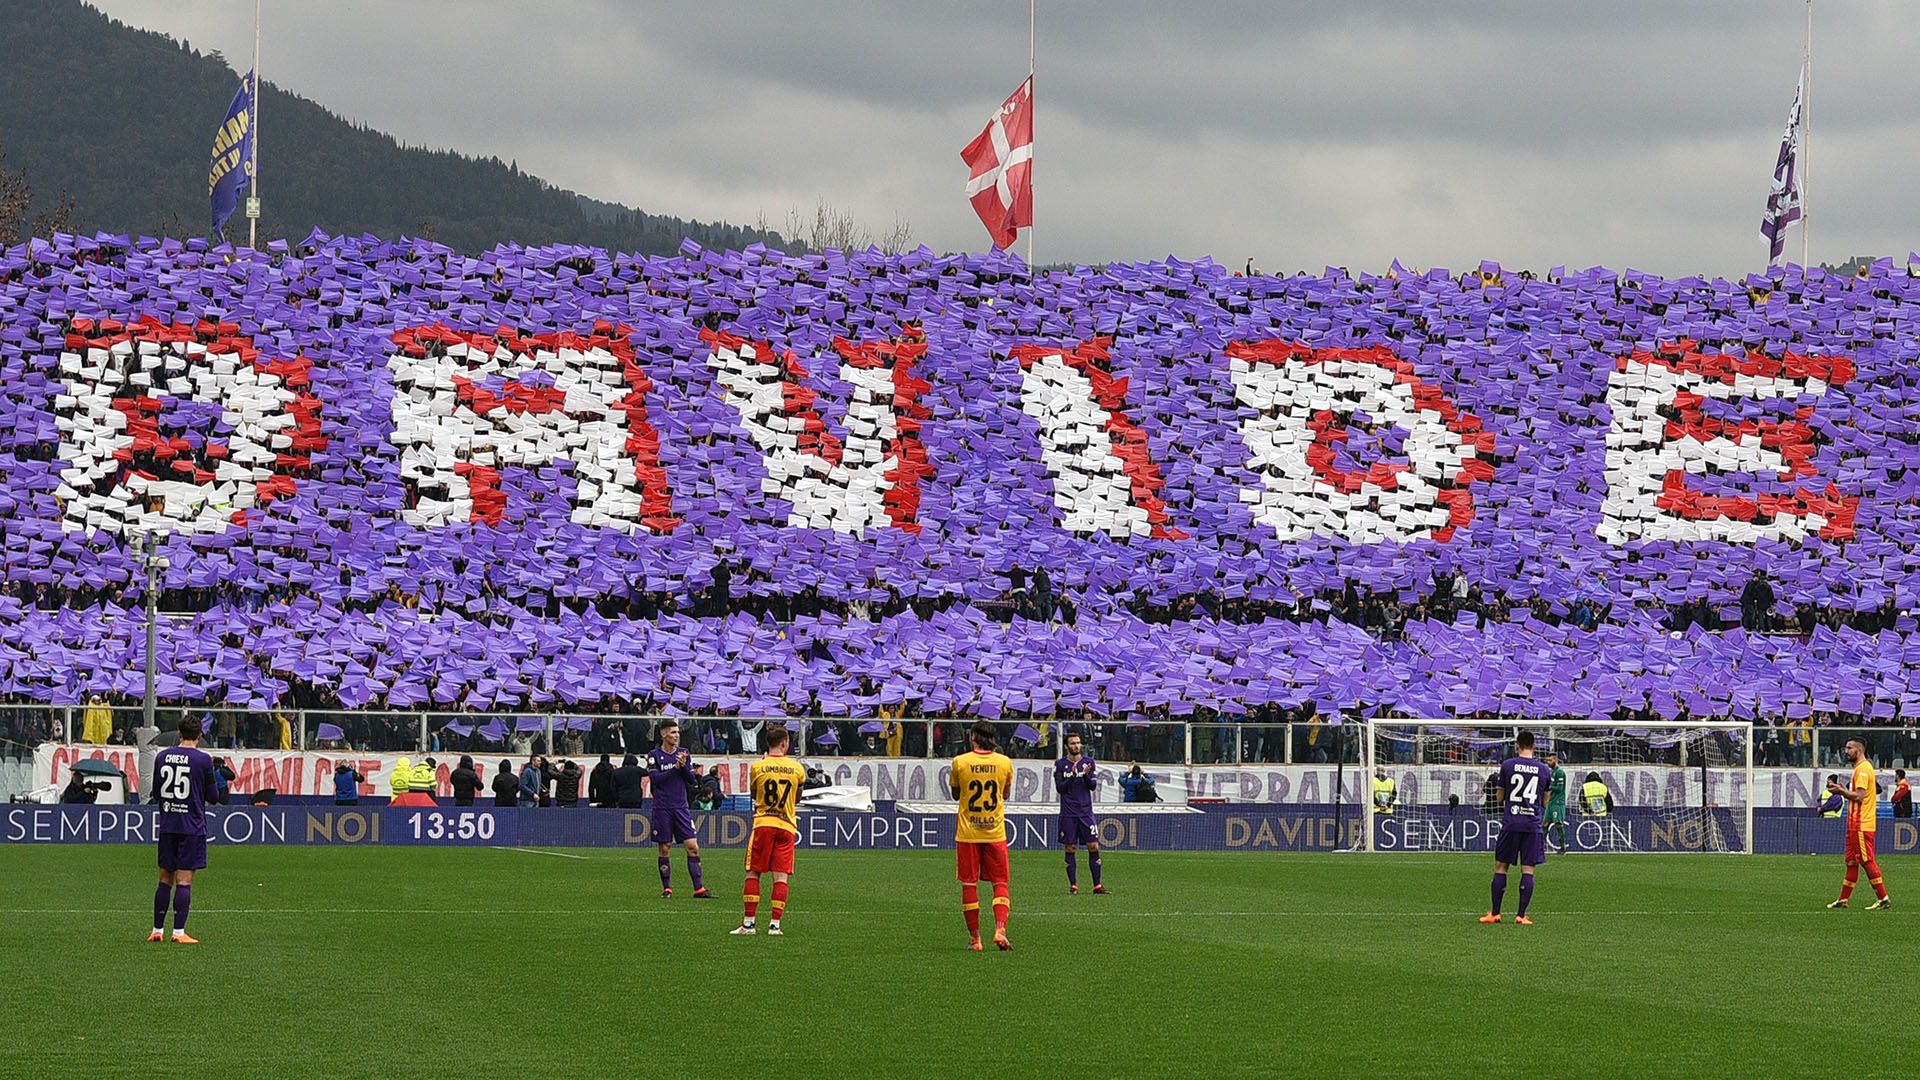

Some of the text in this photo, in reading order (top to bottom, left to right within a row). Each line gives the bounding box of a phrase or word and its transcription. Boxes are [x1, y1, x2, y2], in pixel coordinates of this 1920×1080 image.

[54, 313, 1858, 546] DAVIDE
[165, 754, 189, 765] CHIESA
[761, 766, 795, 775] LOMBARDI
[970, 765, 996, 773] VENUTI
[1514, 764, 1539, 774] BENASSI
[160, 765, 191, 800] 25
[314, 757, 381, 797] CE
[1771, 771, 1822, 807] IN
[764, 779, 792, 808] 87
[968, 779, 997, 812] 23
[1510, 773, 1539, 804] 24
[306, 812, 379, 842] NOI
[408, 812, 495, 839] 13:50
[1380, 818, 1502, 850] SEMPR
